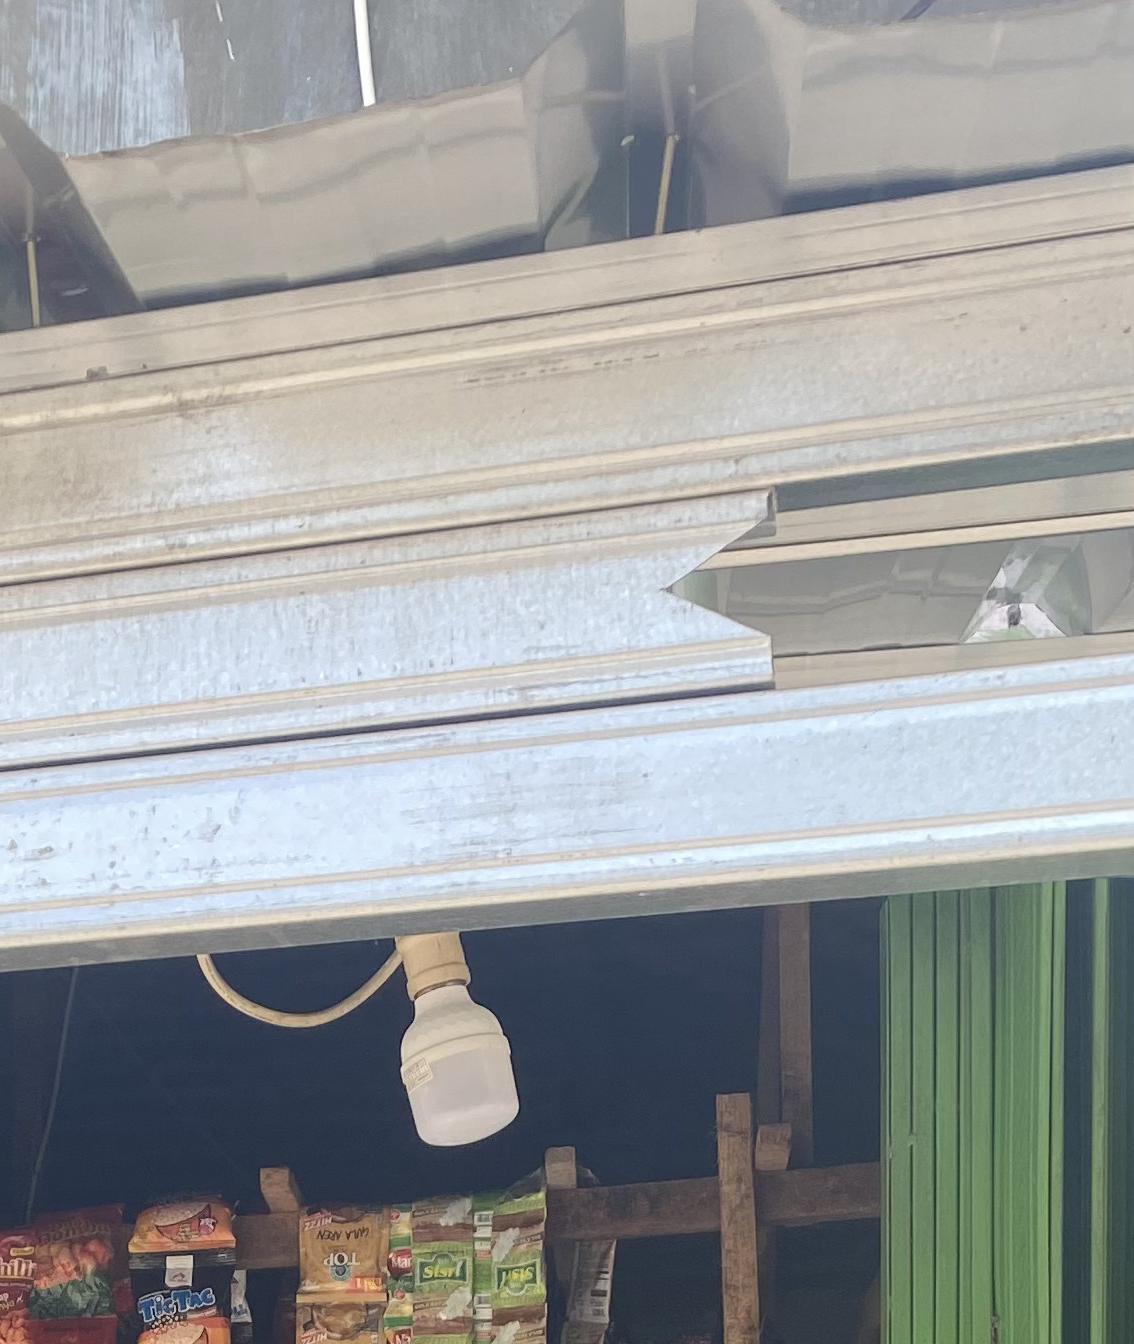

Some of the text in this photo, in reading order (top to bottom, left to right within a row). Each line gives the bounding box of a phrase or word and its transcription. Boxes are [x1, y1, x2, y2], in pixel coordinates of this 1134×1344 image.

[316, 1228, 339, 1241] AREN
[323, 1252, 360, 1267] TOP
[138, 1288, 216, 1323] TicTac
